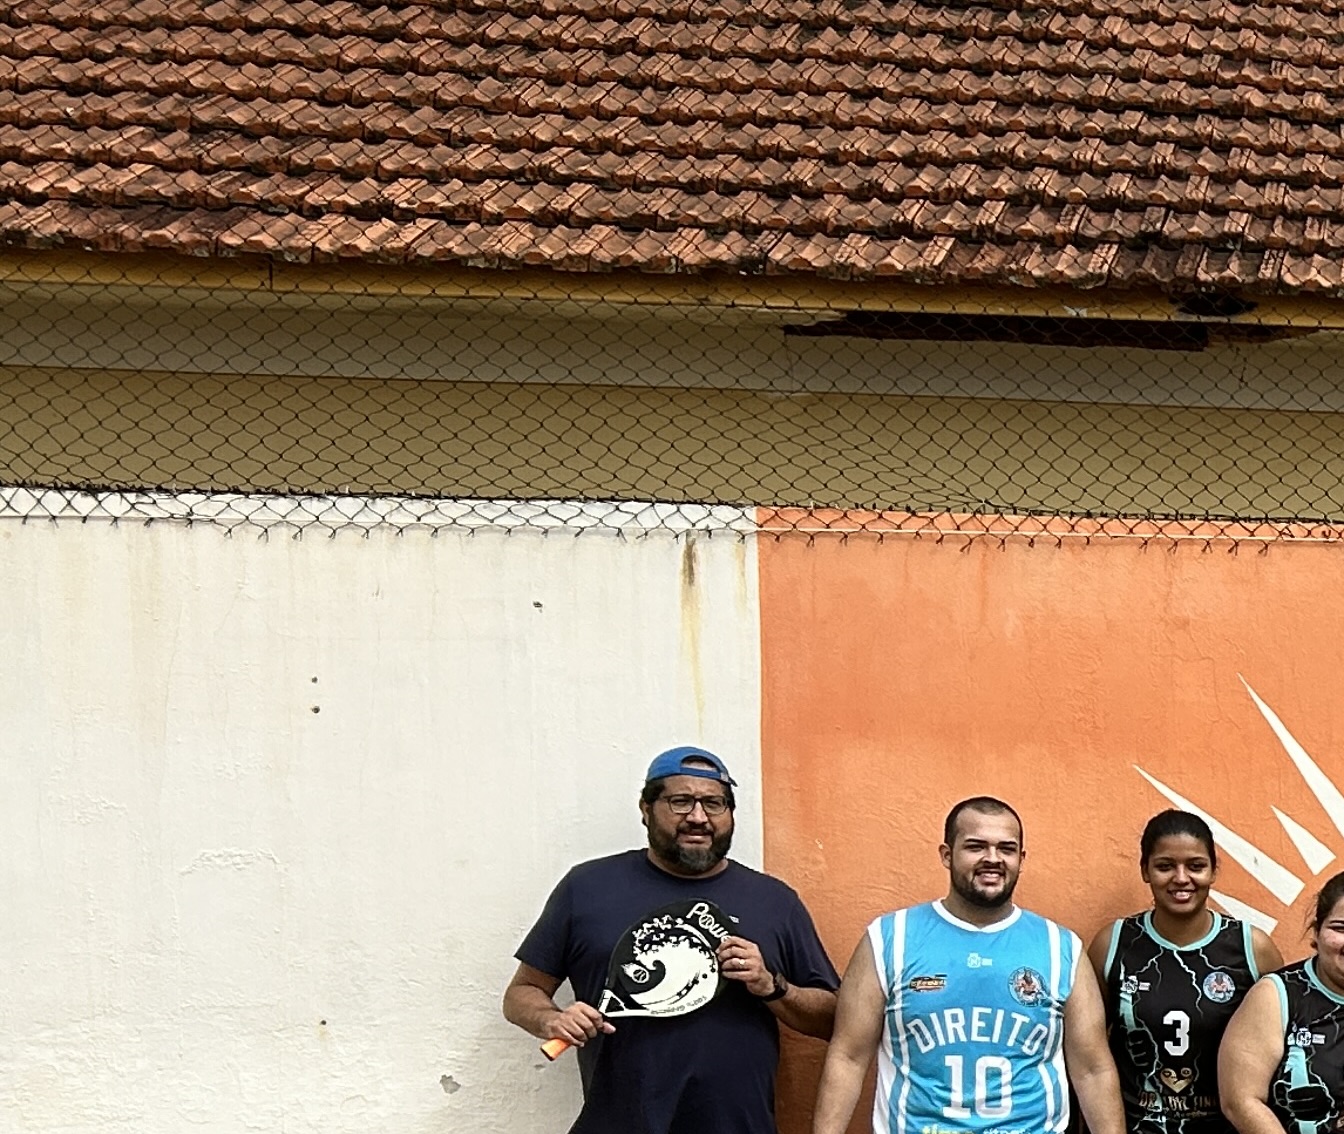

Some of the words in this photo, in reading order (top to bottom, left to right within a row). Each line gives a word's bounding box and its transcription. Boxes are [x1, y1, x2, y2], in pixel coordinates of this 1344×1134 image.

[906, 1006, 1049, 1057] DIREITO
[1162, 1010, 1191, 1057] 3
[942, 1055, 1014, 1119] 10
